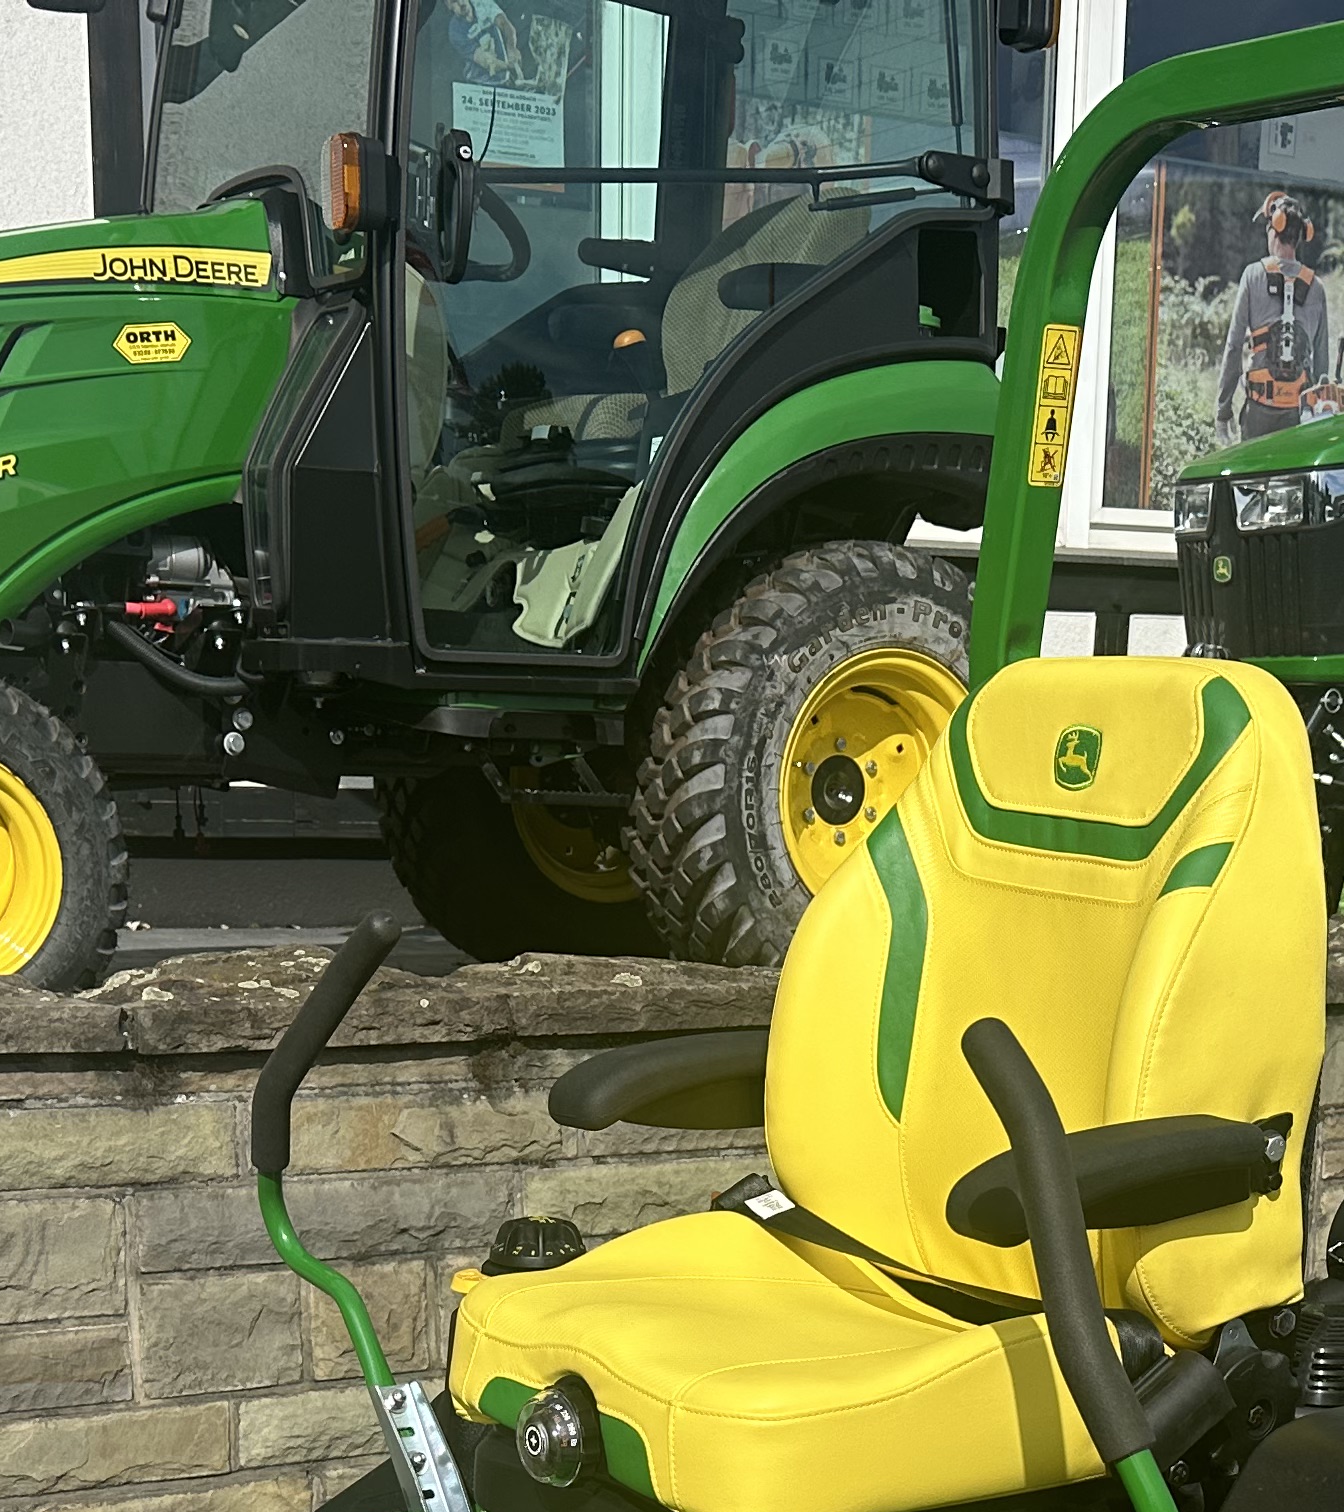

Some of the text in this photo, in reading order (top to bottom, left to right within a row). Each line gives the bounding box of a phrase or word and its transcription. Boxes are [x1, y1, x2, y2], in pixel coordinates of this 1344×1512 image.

[534, 105, 557, 116] 2023
[93, 252, 259, 284] JOHN DEERE
[125, 329, 177, 344] ORTH
